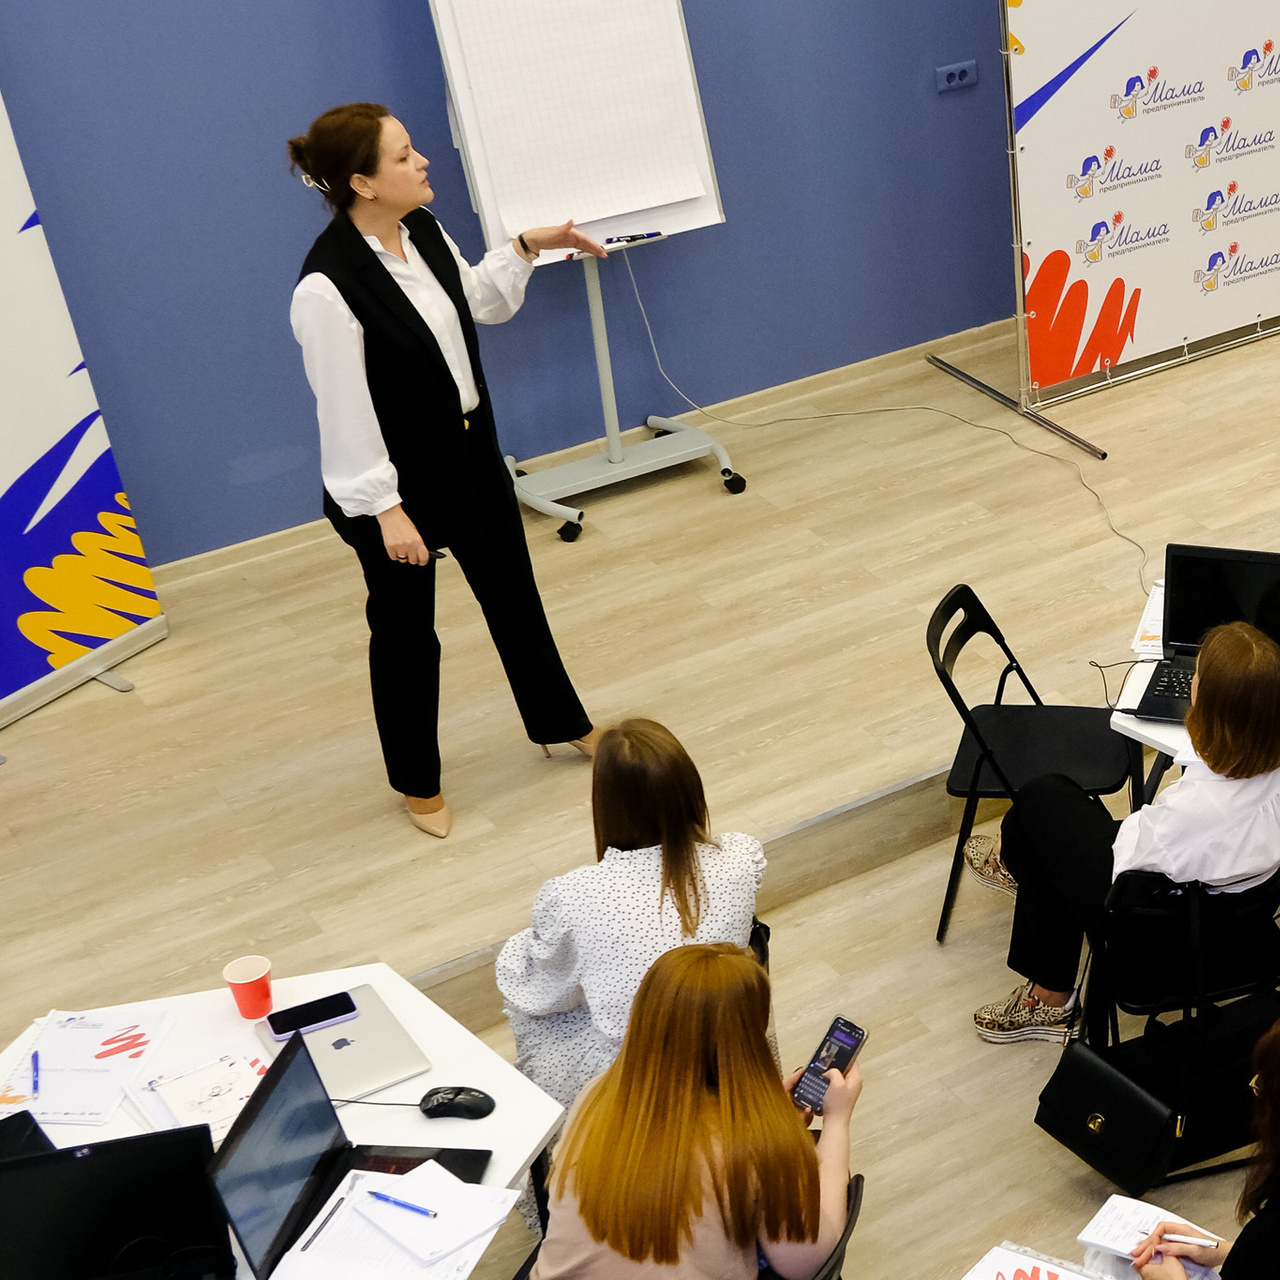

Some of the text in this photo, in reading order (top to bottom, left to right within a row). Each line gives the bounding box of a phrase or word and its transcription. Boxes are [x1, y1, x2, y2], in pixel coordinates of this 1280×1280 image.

[1142, 80, 1205, 105] Мама
[1142, 95, 1205, 115] предприниматель
[1216, 129, 1275, 156] Мама
[1216, 144, 1275, 164] предприниматель
[1101, 158, 1162, 184] Мама
[1099, 173, 1162, 194] предприниматель
[1222, 206, 1280, 227] предприниматель
[1223, 192, 1280, 218] Мама
[1108, 223, 1169, 249] Мама
[1108, 237, 1170, 258] предприниматель
[1223, 267, 1280, 287] предприниматель
[1224, 252, 1280, 279] Мама
